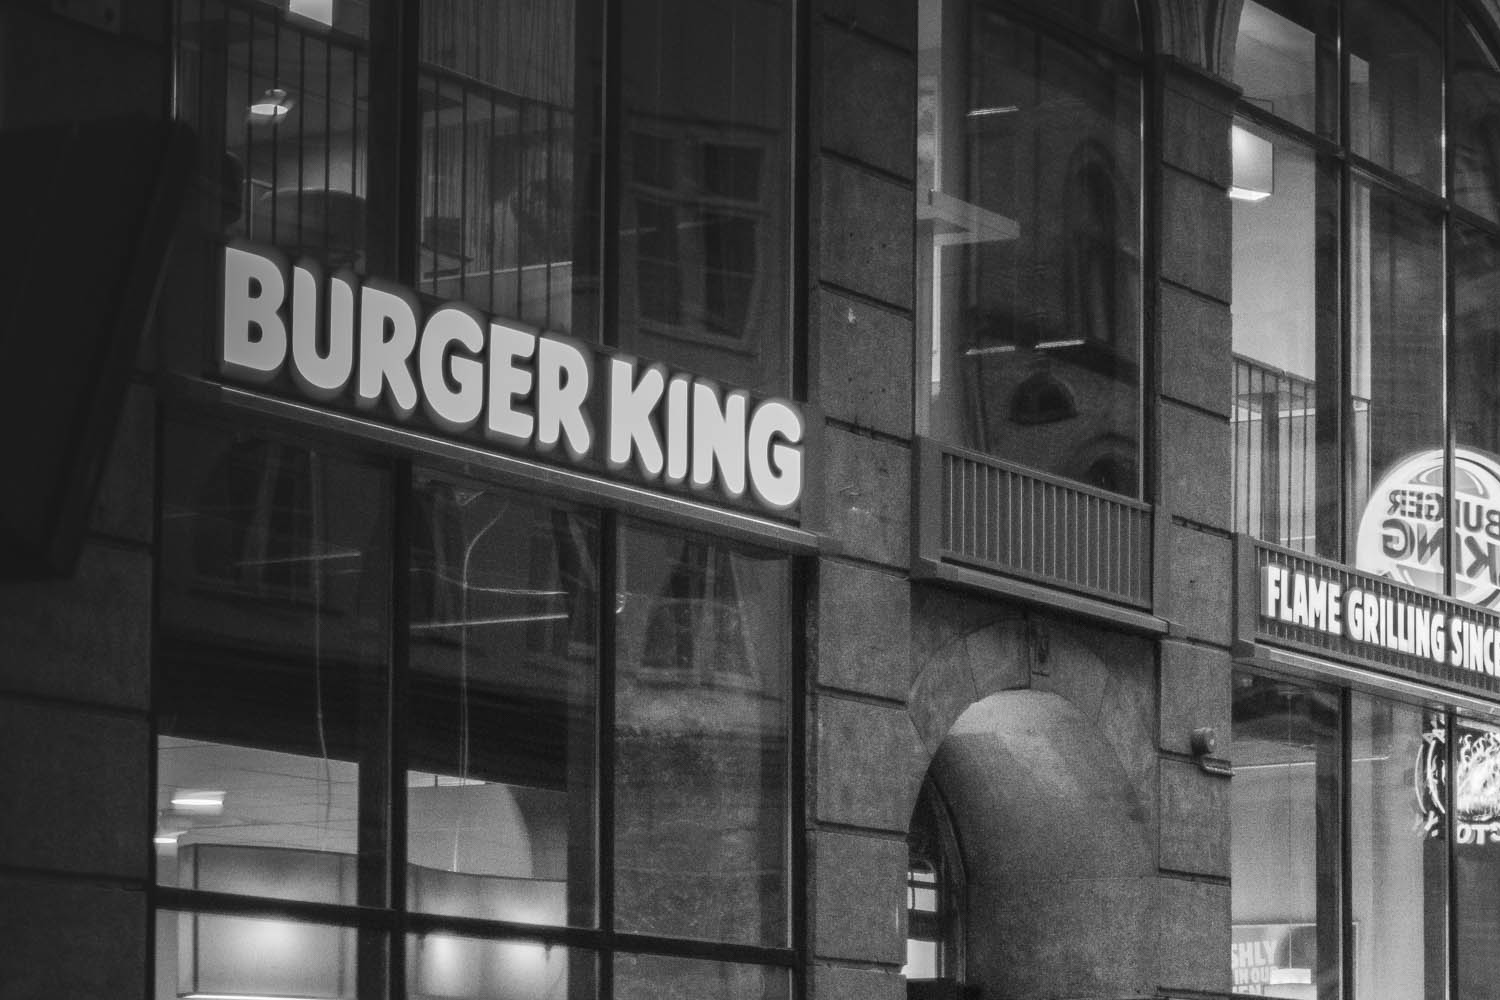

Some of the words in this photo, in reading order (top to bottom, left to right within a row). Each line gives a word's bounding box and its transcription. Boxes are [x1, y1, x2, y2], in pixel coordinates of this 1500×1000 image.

[224, 247, 590, 456] BURGER
[609, 357, 801, 507] KING
[1265, 564, 1342, 635] FLAME
[1349, 589, 1445, 663] GRILLING
